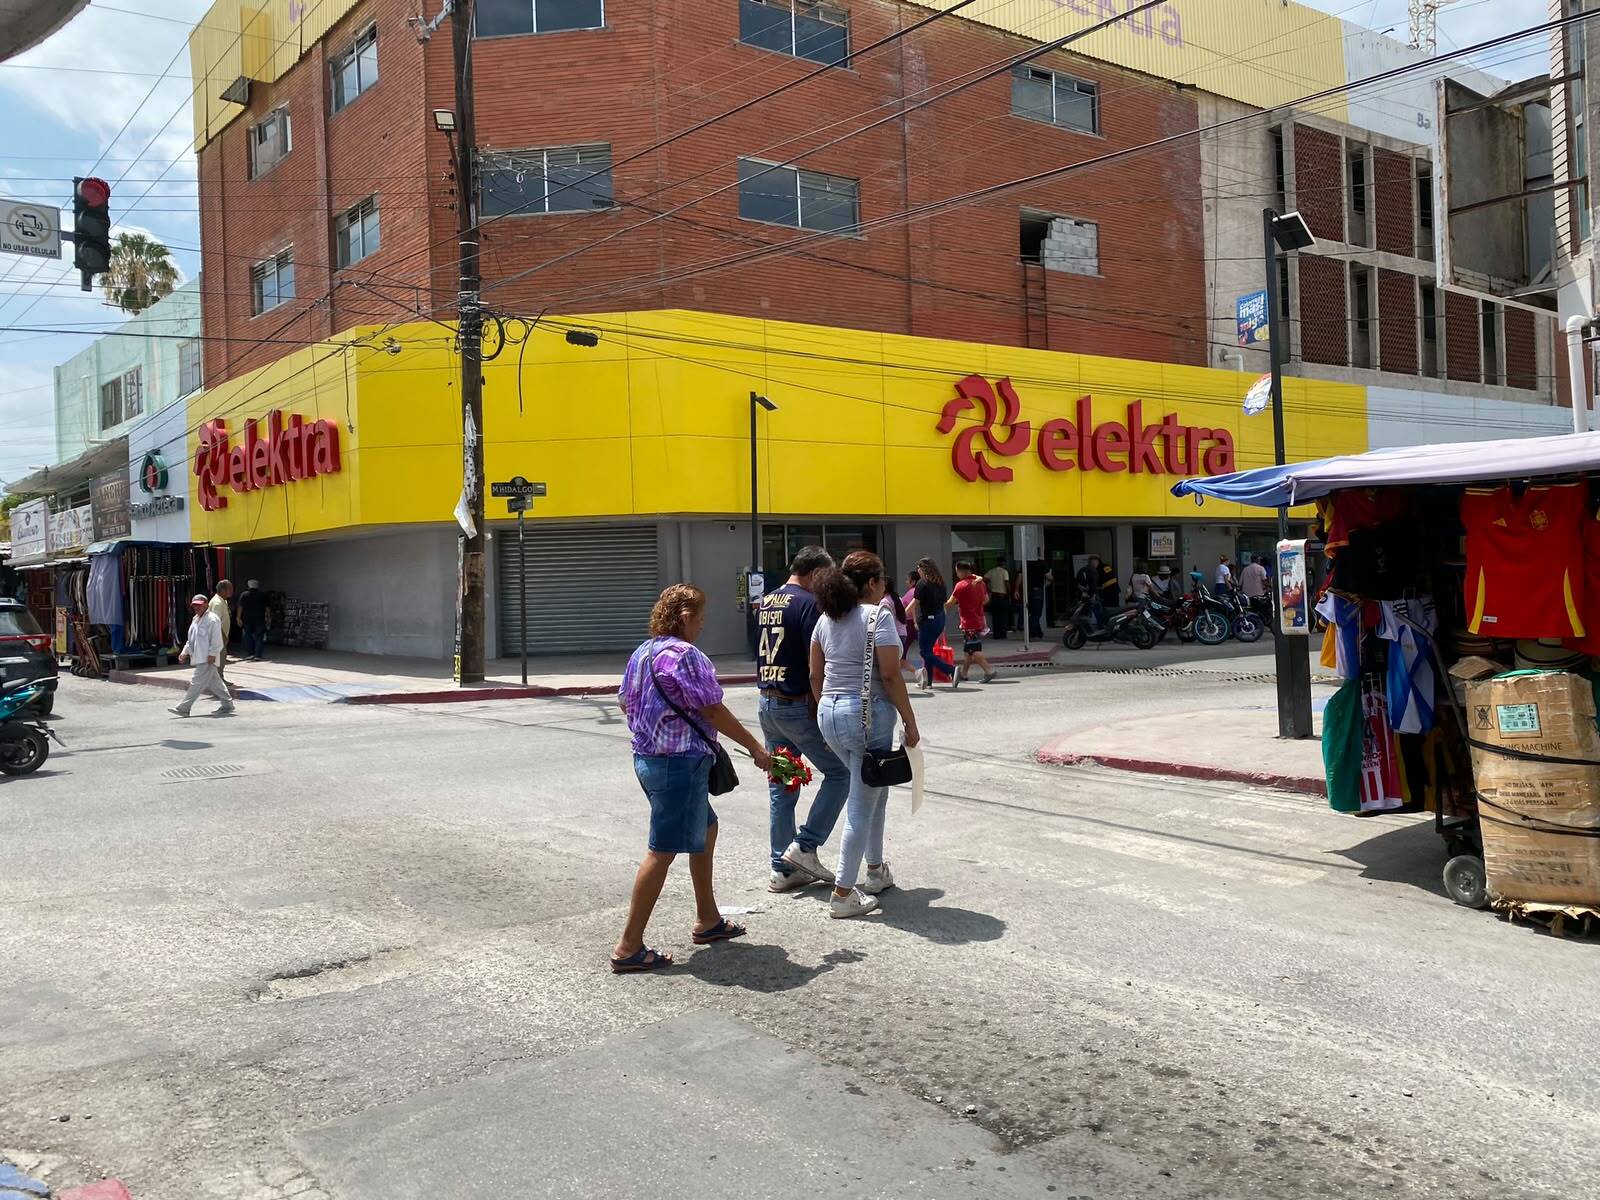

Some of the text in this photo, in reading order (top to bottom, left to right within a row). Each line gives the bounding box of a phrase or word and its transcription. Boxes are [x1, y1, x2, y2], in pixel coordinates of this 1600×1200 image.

[13, 244, 30, 252] USAR
[31, 246, 57, 256] CELULAR
[230, 409, 340, 496] elektra
[1038, 395, 1236, 477] elektra
[759, 627, 785, 664] 47
[1521, 742, 1563, 751] MACHINE
